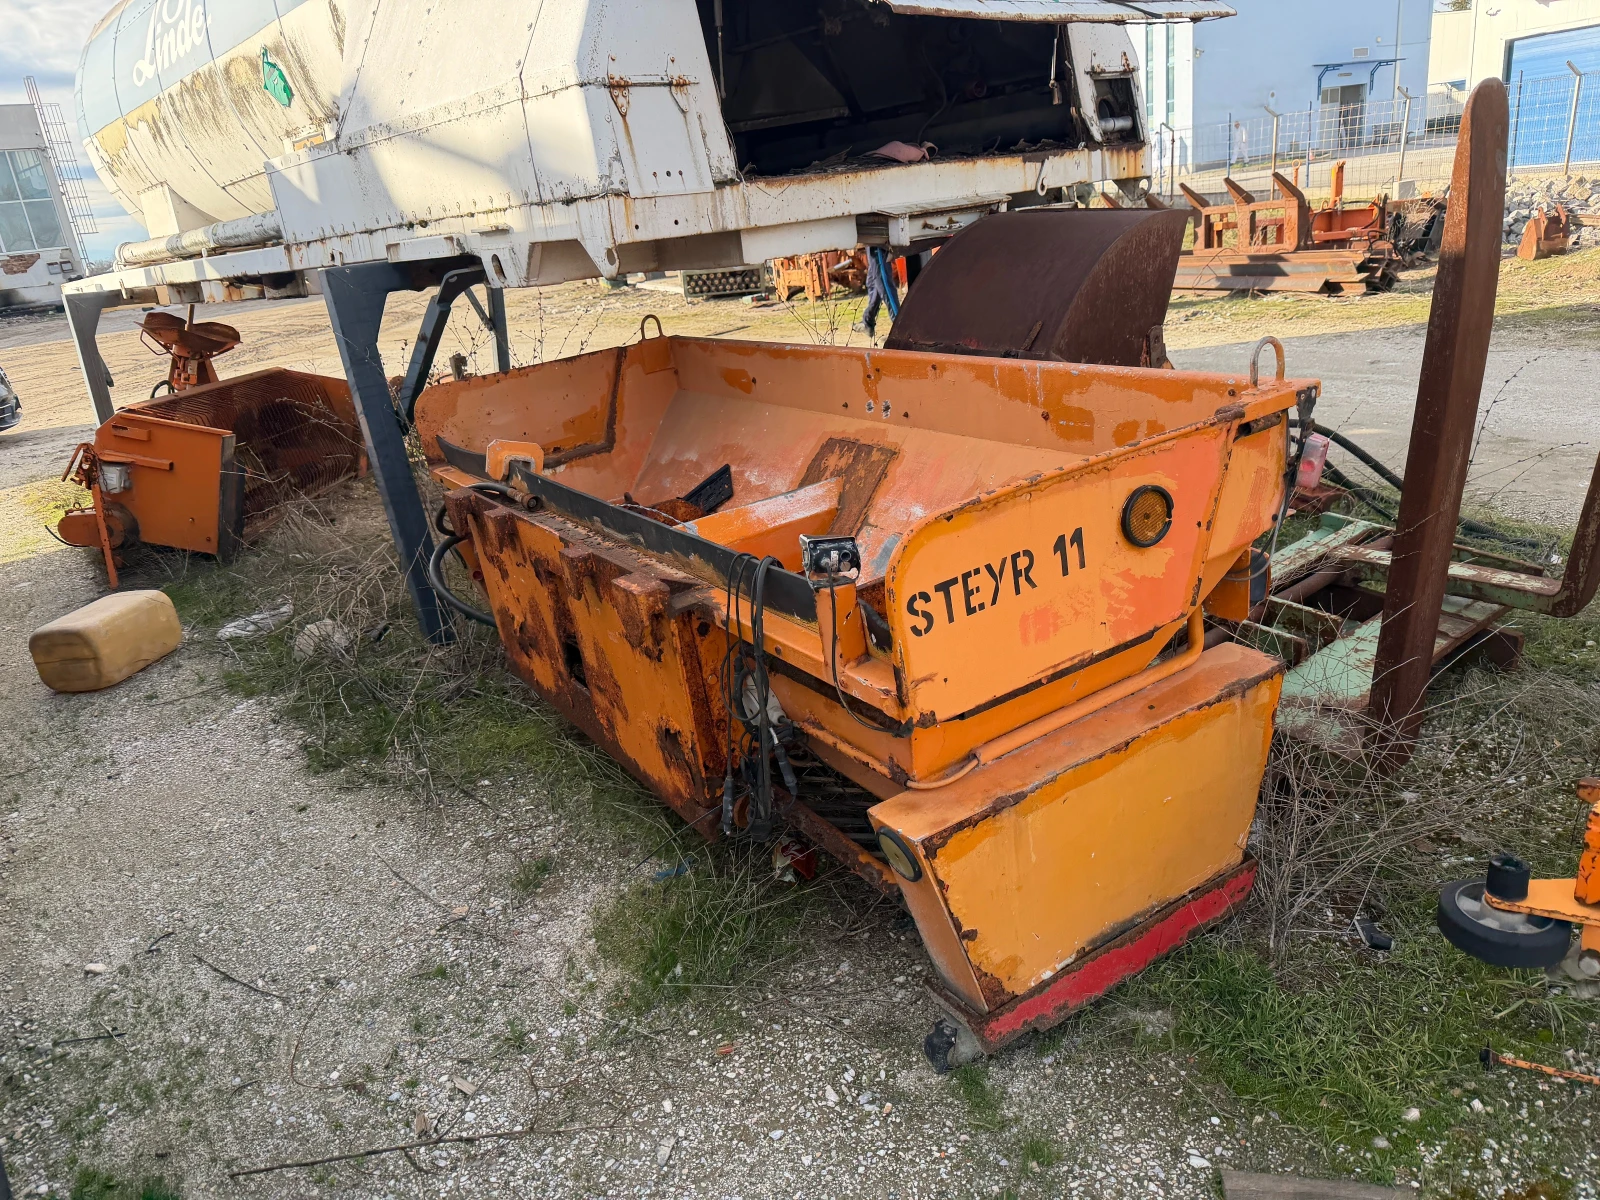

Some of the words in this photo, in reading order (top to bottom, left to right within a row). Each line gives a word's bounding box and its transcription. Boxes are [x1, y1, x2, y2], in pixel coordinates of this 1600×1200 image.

[132, 0, 211, 87] Linde
[906, 549, 1038, 637] STEYR
[1053, 527, 1086, 577] 11
